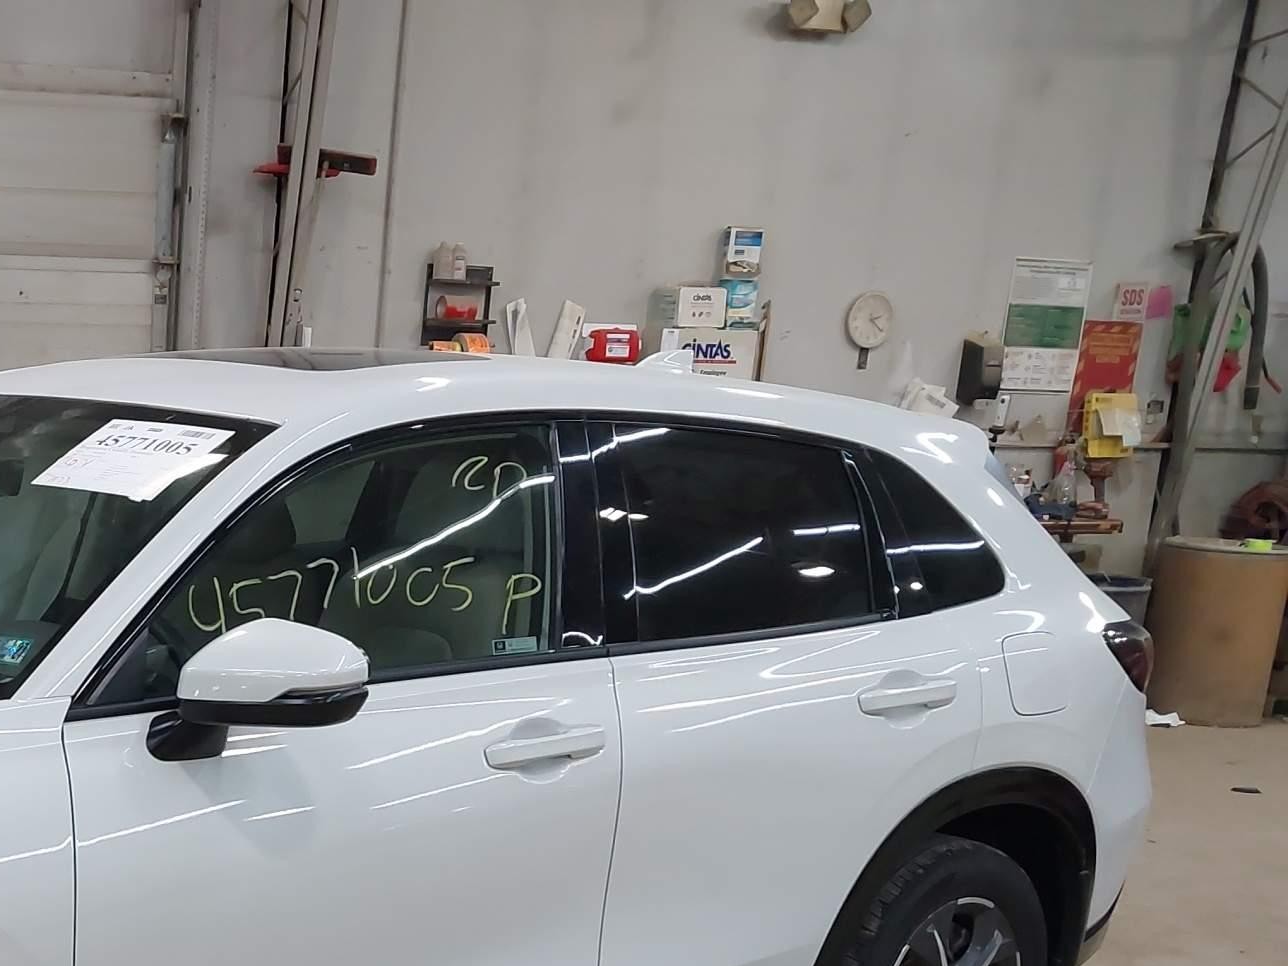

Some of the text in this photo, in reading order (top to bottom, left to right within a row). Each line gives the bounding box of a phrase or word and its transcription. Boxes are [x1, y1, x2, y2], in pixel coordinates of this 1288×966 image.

[1121, 288, 1145, 306] SDS
[96, 434, 199, 456] 45771005
[501, 573, 542, 635] P
